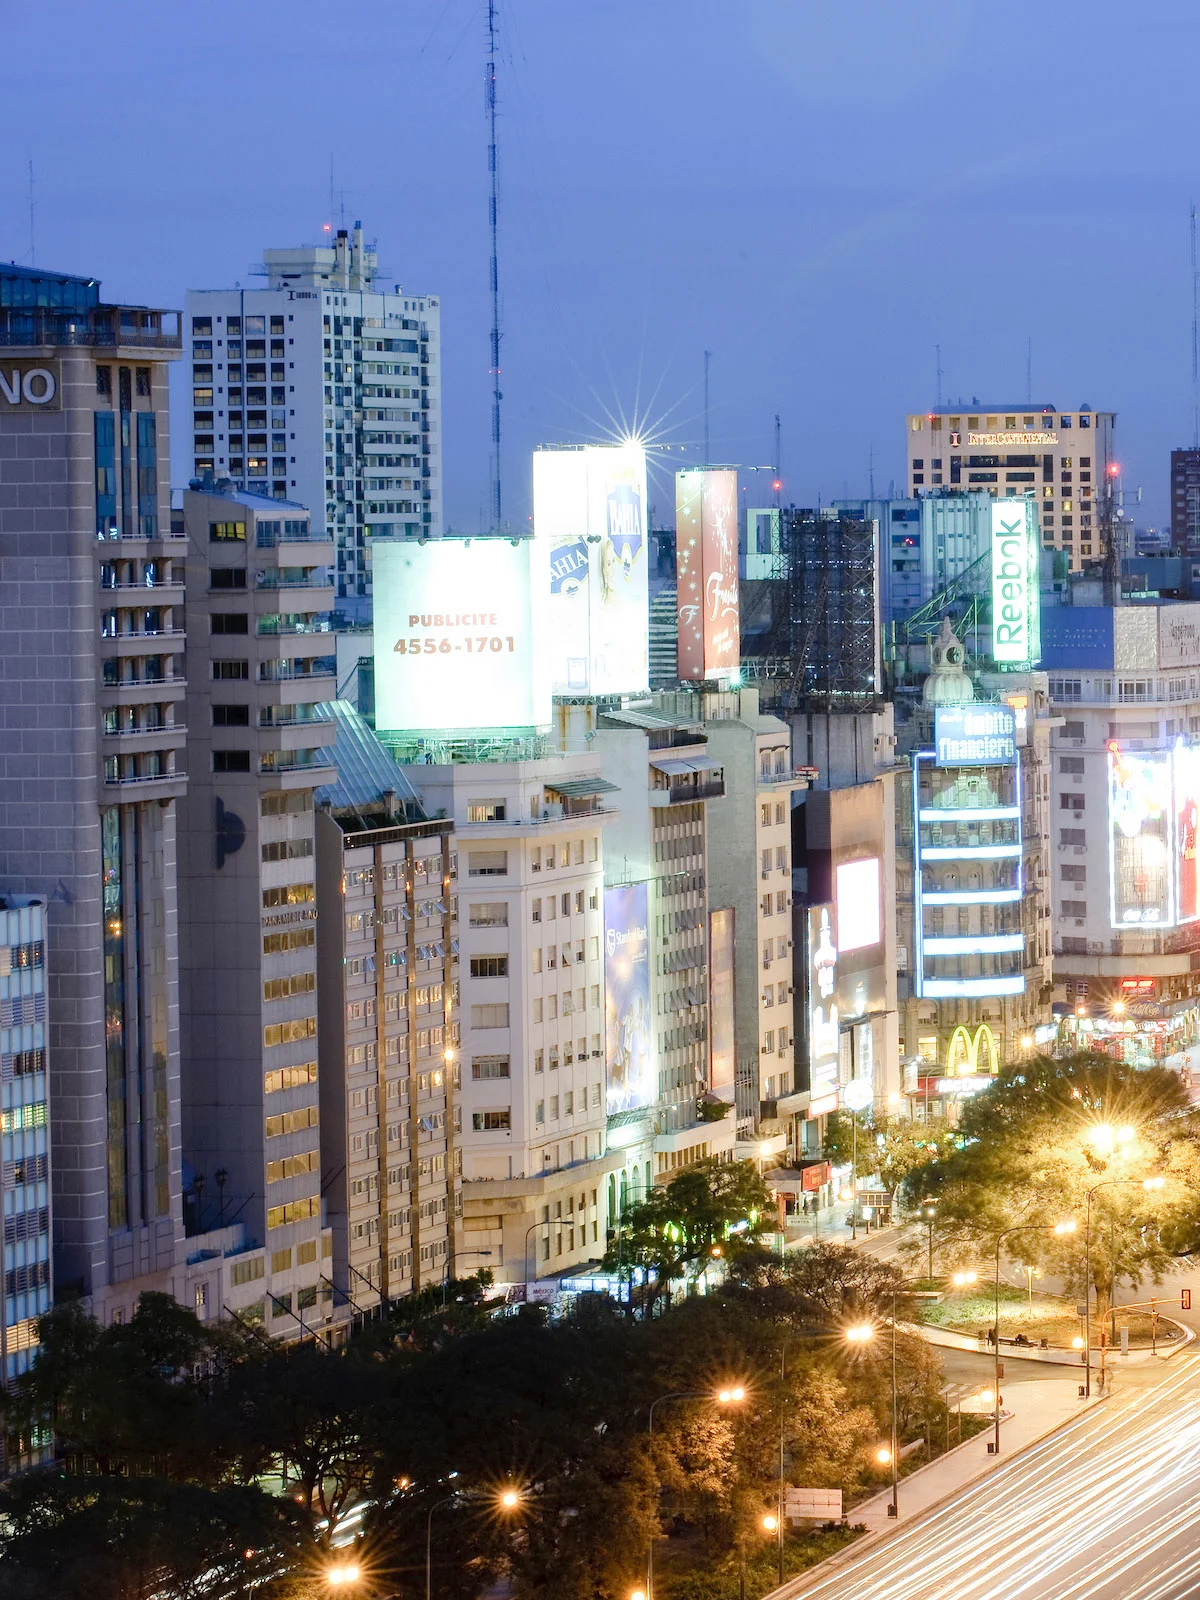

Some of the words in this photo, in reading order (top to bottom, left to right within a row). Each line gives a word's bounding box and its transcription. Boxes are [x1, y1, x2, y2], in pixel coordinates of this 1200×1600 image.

[0, 368, 56, 405] NO
[996, 518, 1023, 645] Reebok
[408, 613, 498, 628] PUBLICITE
[393, 636, 515, 655] 4556-1701
[938, 736, 1014, 761] financiero
